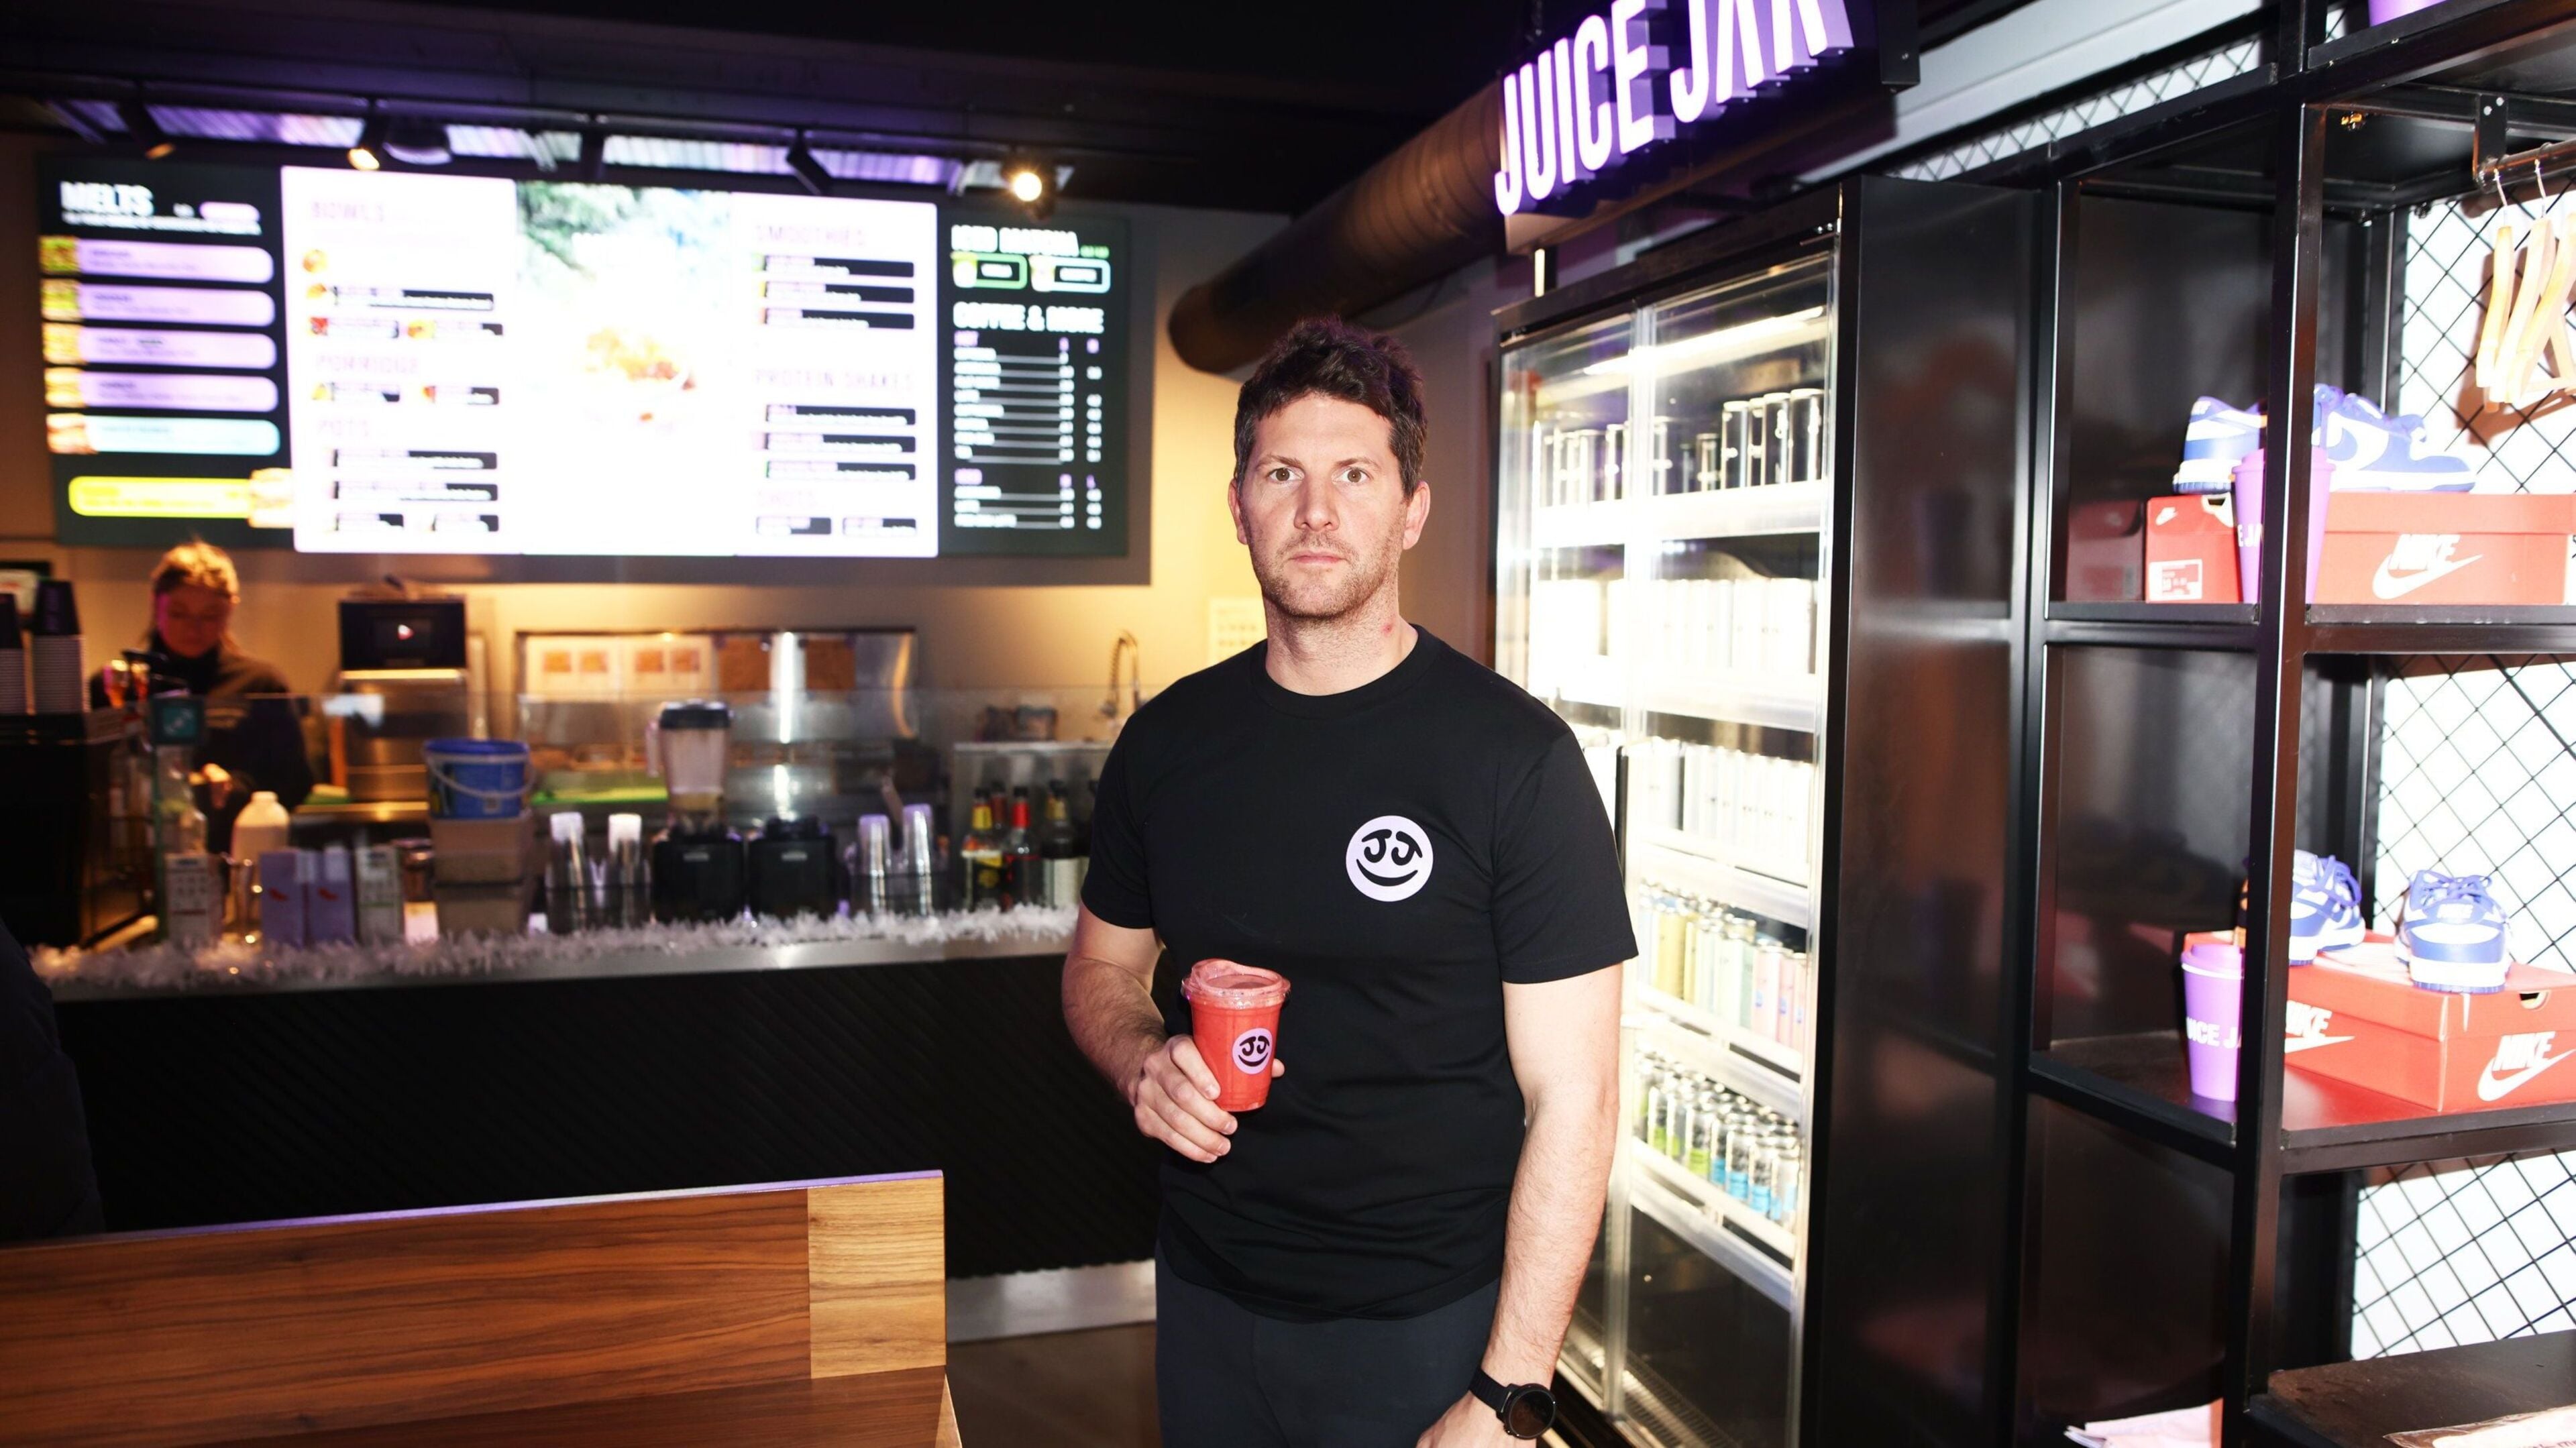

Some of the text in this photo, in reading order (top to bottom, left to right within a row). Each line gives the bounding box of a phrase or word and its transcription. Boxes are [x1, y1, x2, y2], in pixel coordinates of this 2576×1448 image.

[1495, 0, 1654, 215] JUICE
[60, 181, 154, 215] MELTS
[2388, 533, 2461, 571] NIKE
[2491, 1031, 2556, 1071] NIKE
